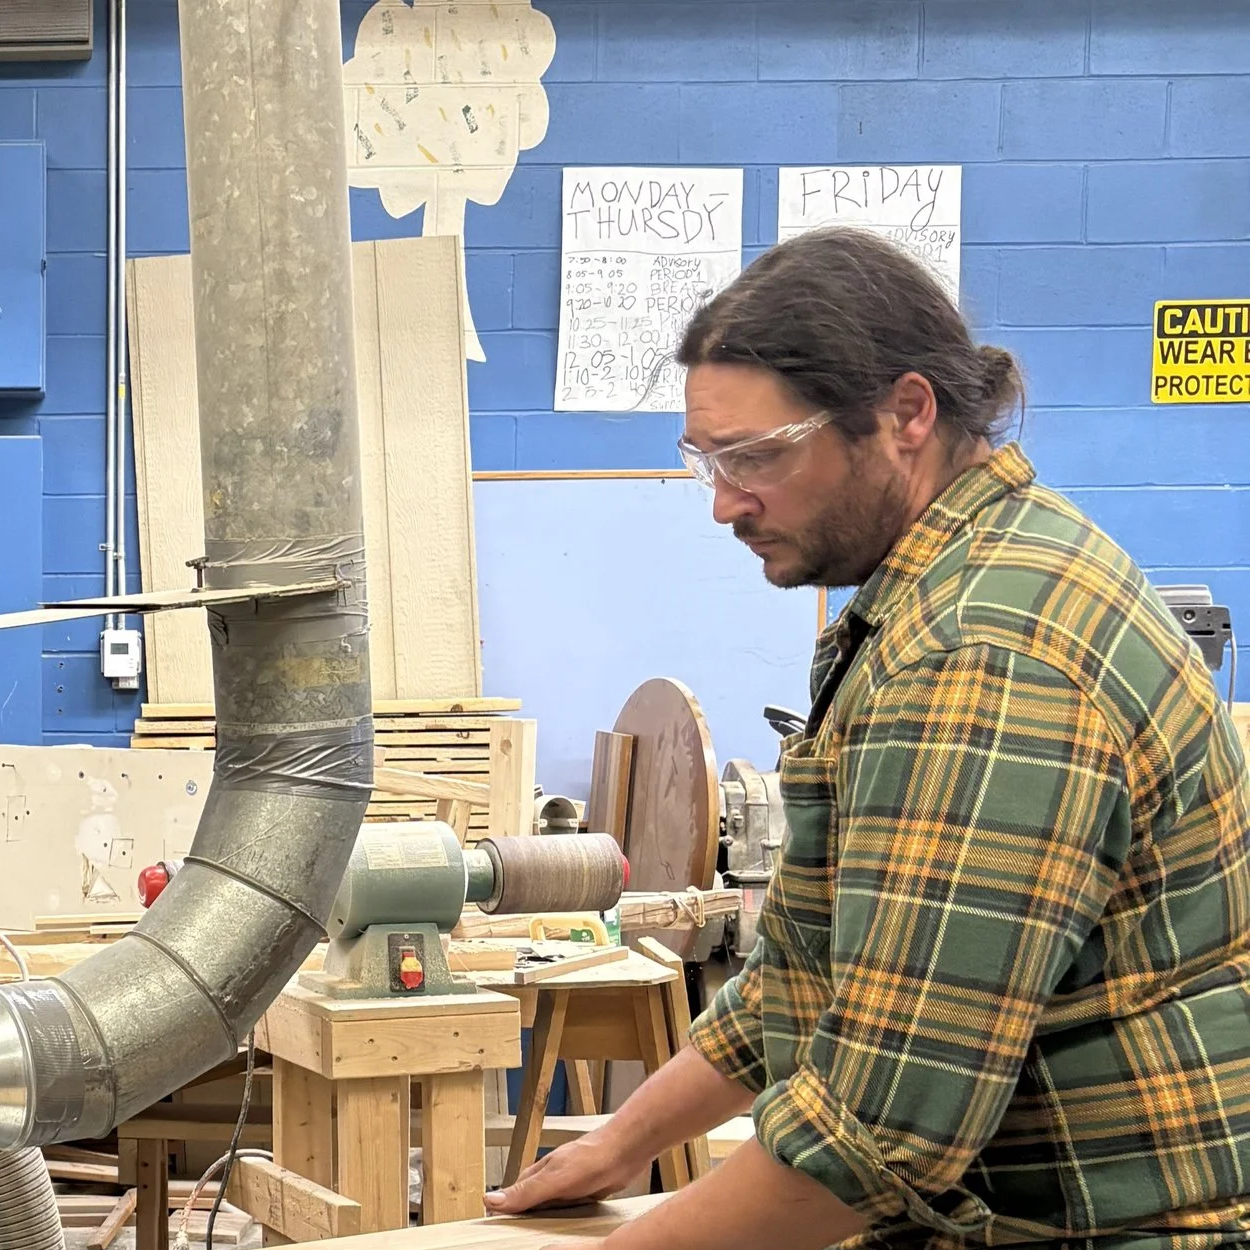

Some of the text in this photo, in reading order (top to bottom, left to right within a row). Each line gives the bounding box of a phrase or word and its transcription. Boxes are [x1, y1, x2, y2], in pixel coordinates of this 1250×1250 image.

[571, 180, 695, 209] MONDAY
[566, 201, 724, 244] THURSDY
[1164, 308, 1249, 334] CAUTI
[1159, 340, 1235, 364] WEAR
